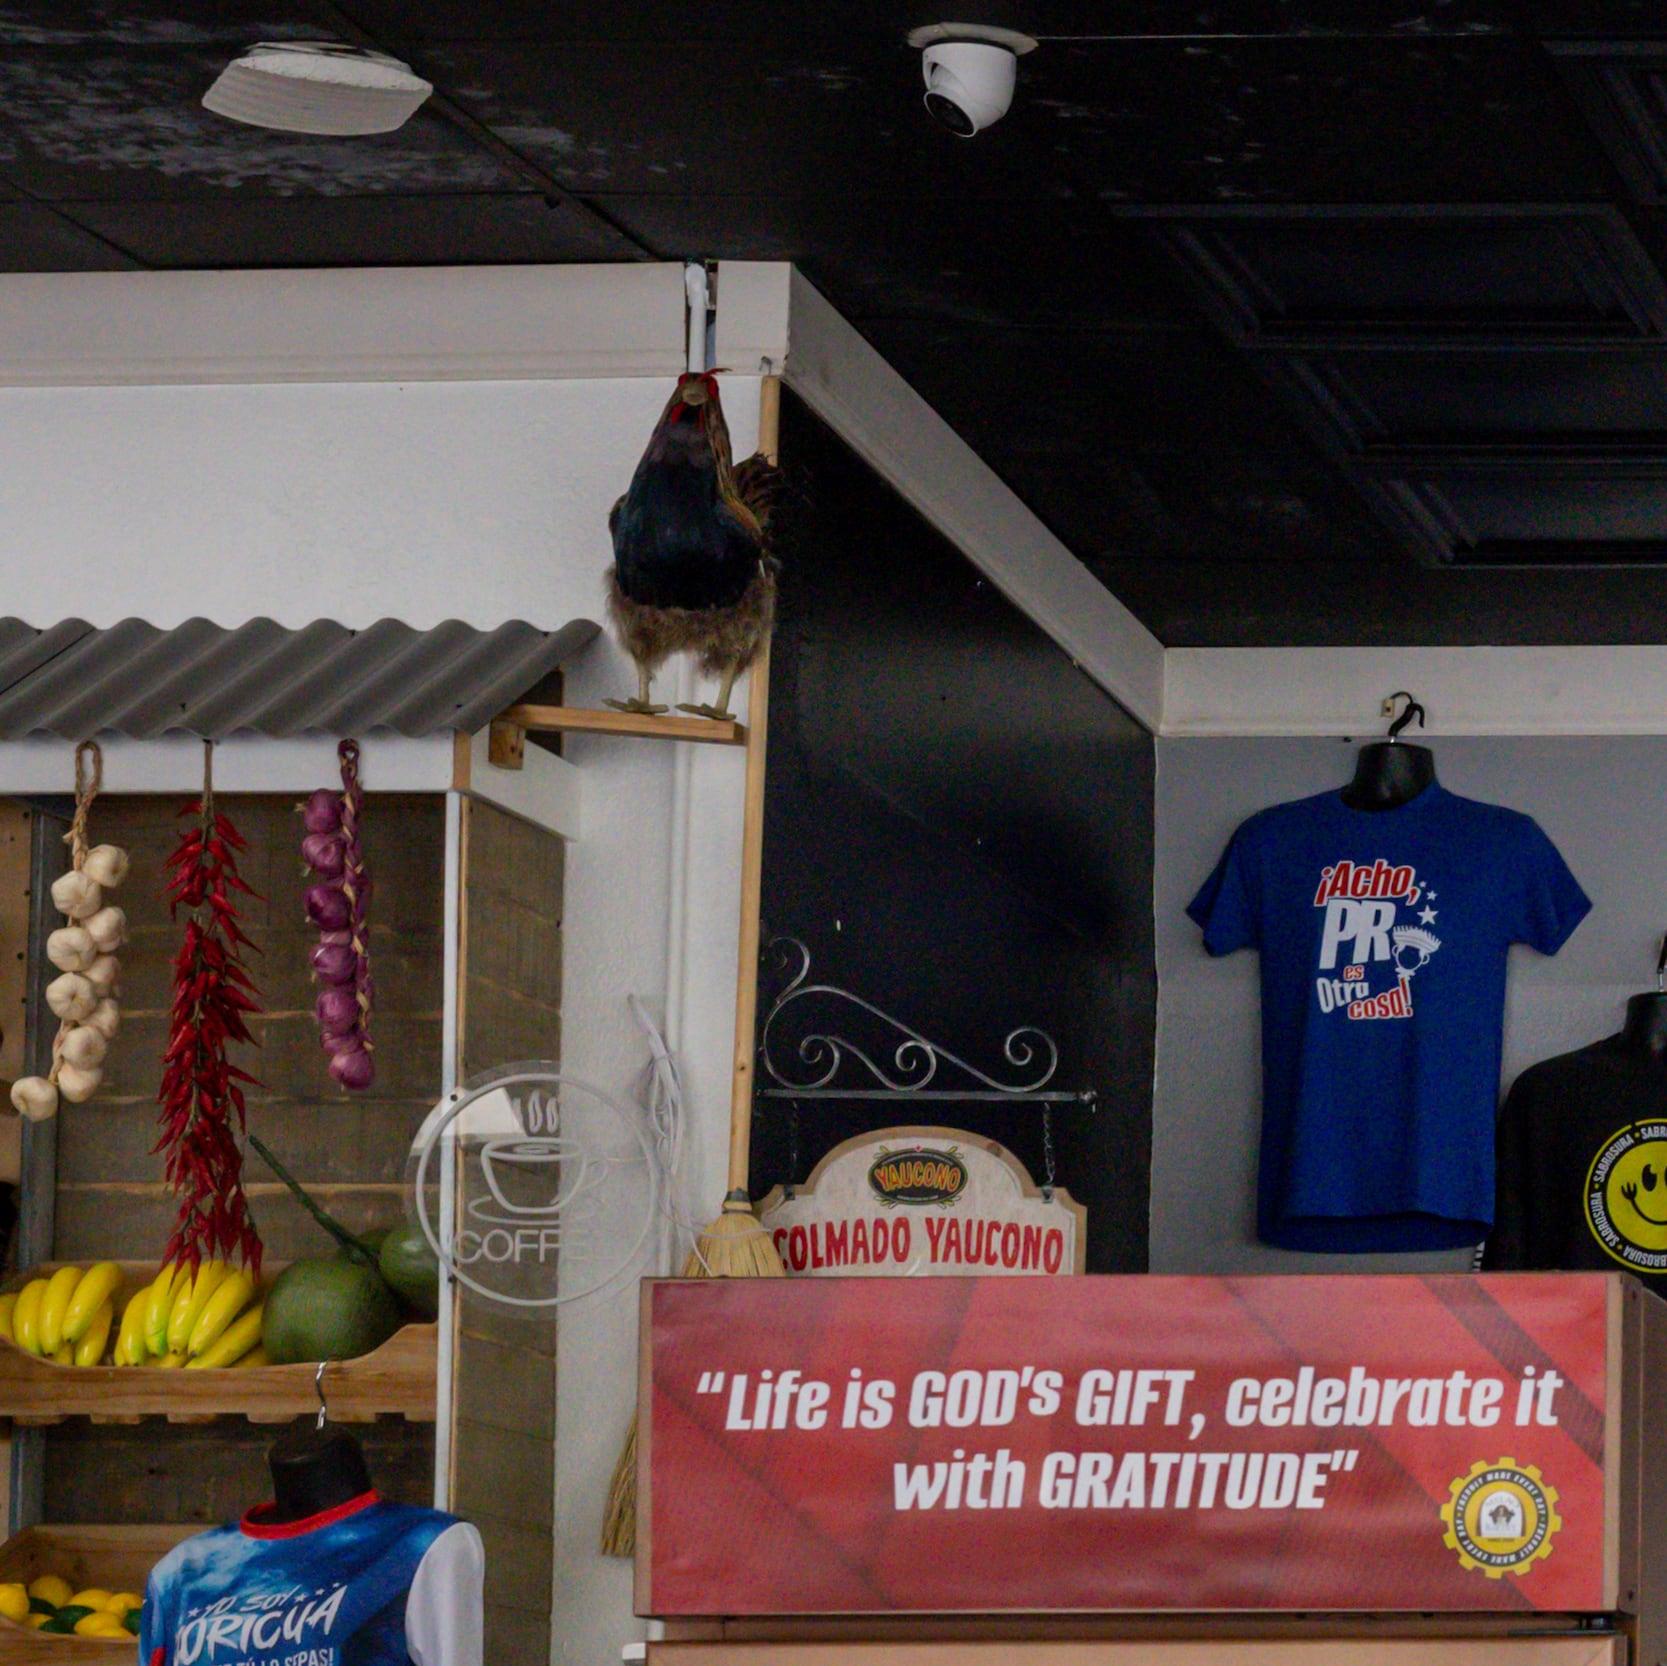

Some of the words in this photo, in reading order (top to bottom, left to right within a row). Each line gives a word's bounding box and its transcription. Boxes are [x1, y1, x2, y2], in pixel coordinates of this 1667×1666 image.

[1319, 899, 1396, 969] PR
[1344, 965, 1365, 980] es
[875, 1161, 961, 1192] YAUCONO
[1593, 1134, 1635, 1183] SABROSURA
[773, 1216, 911, 1272] COLMADO
[925, 1216, 1063, 1275] YAUCONO
[841, 1368, 894, 1430] is
[1075, 1369, 1206, 1439] GIFT,
[1224, 1366, 1506, 1429] celebrate
[1513, 1366, 1564, 1428] it
[892, 1449, 1027, 1512] with
[1039, 1450, 1358, 1511] GRATITUDE"
